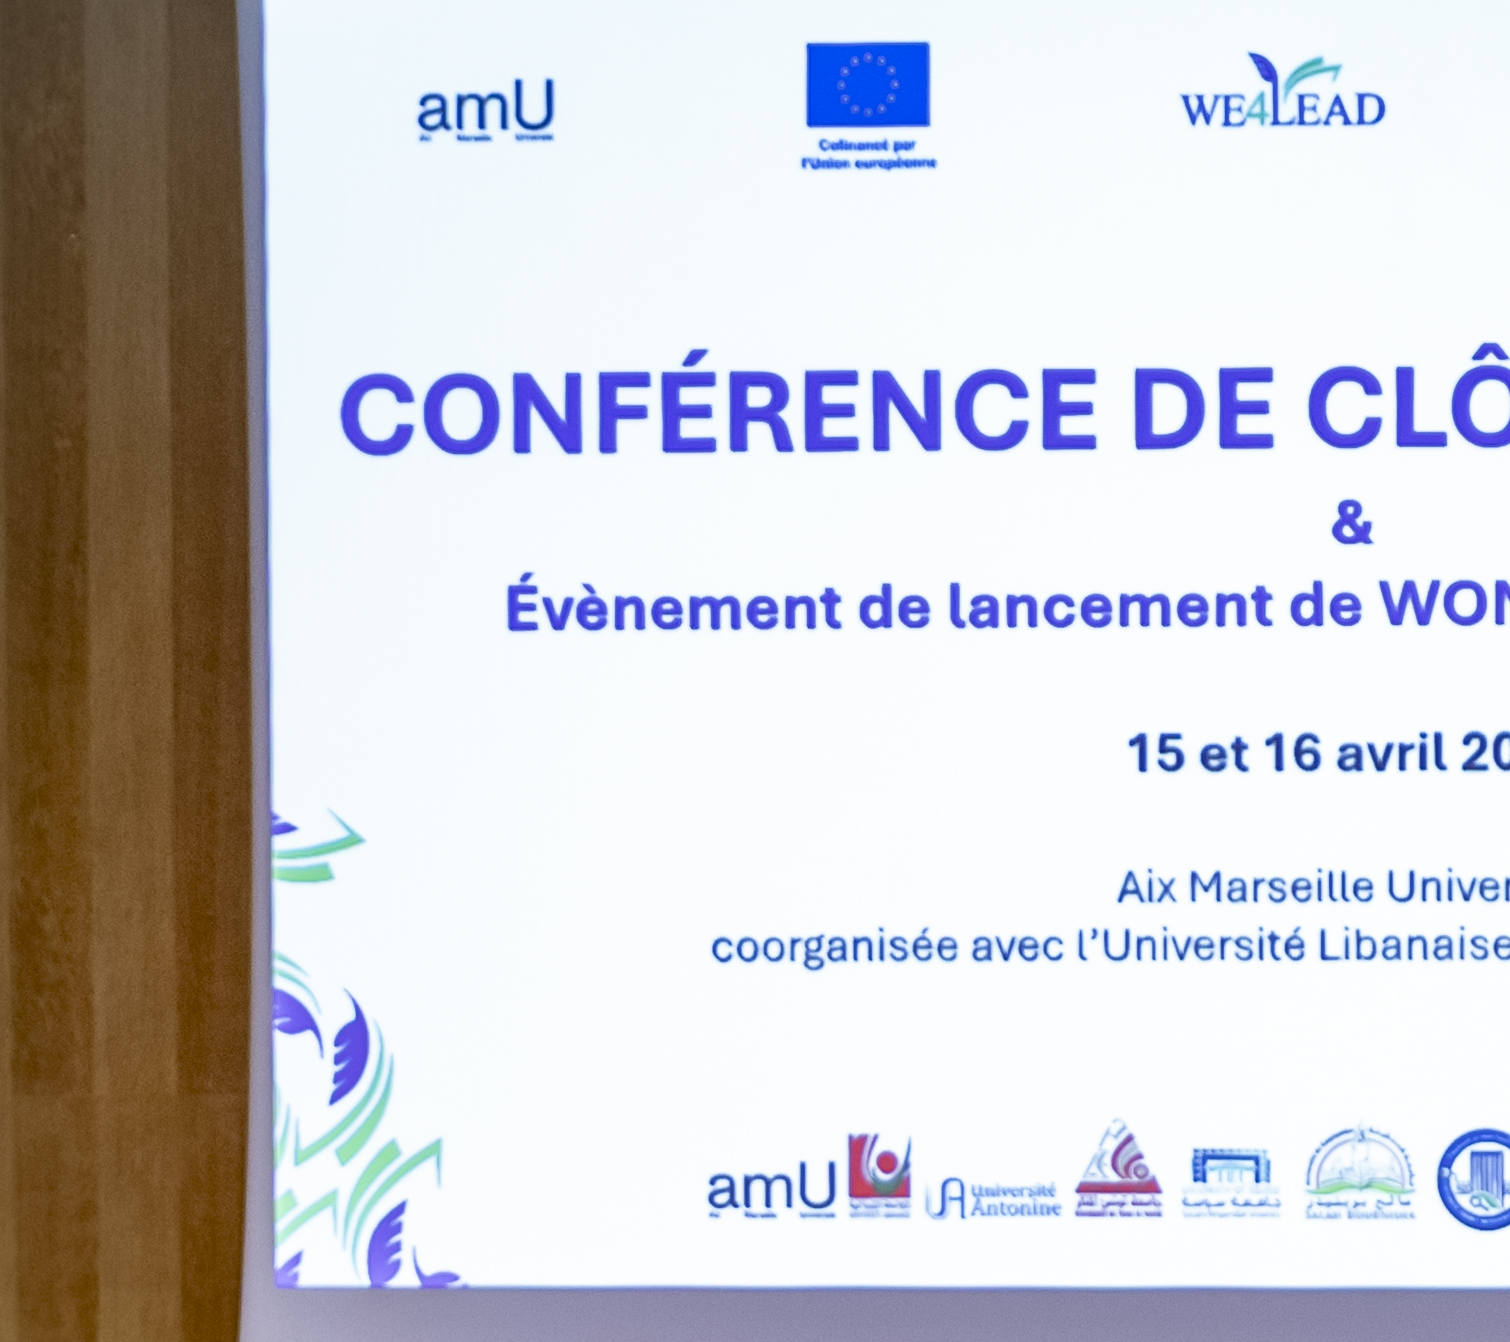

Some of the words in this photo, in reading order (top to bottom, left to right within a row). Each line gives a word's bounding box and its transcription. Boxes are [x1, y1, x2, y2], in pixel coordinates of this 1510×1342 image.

[418, 79, 554, 131] amU
[1180, 74, 1386, 128] WE4LEAD
[339, 348, 1097, 457] CONFÉRENCE
[1134, 366, 1275, 451] DE
[1331, 498, 1374, 545] &
[506, 571, 843, 632] Évènement
[858, 582, 931, 630] de
[949, 582, 1274, 630] lancement
[1289, 579, 1363, 628] de
[1128, 732, 1186, 773] 15
[1199, 736, 1250, 773] et
[1264, 732, 1322, 773] 16
[1336, 731, 1448, 773] avril
[1117, 868, 1177, 904] Aix
[1190, 868, 1374, 904] Marseille
[711, 926, 958, 972] coorganisée
[971, 935, 1064, 963] avec
[1077, 926, 1306, 962] l’Université
[708, 1161, 836, 1209] amU
[971, 1181, 1057, 1199] Université
[971, 1199, 1062, 1216] Antonine
